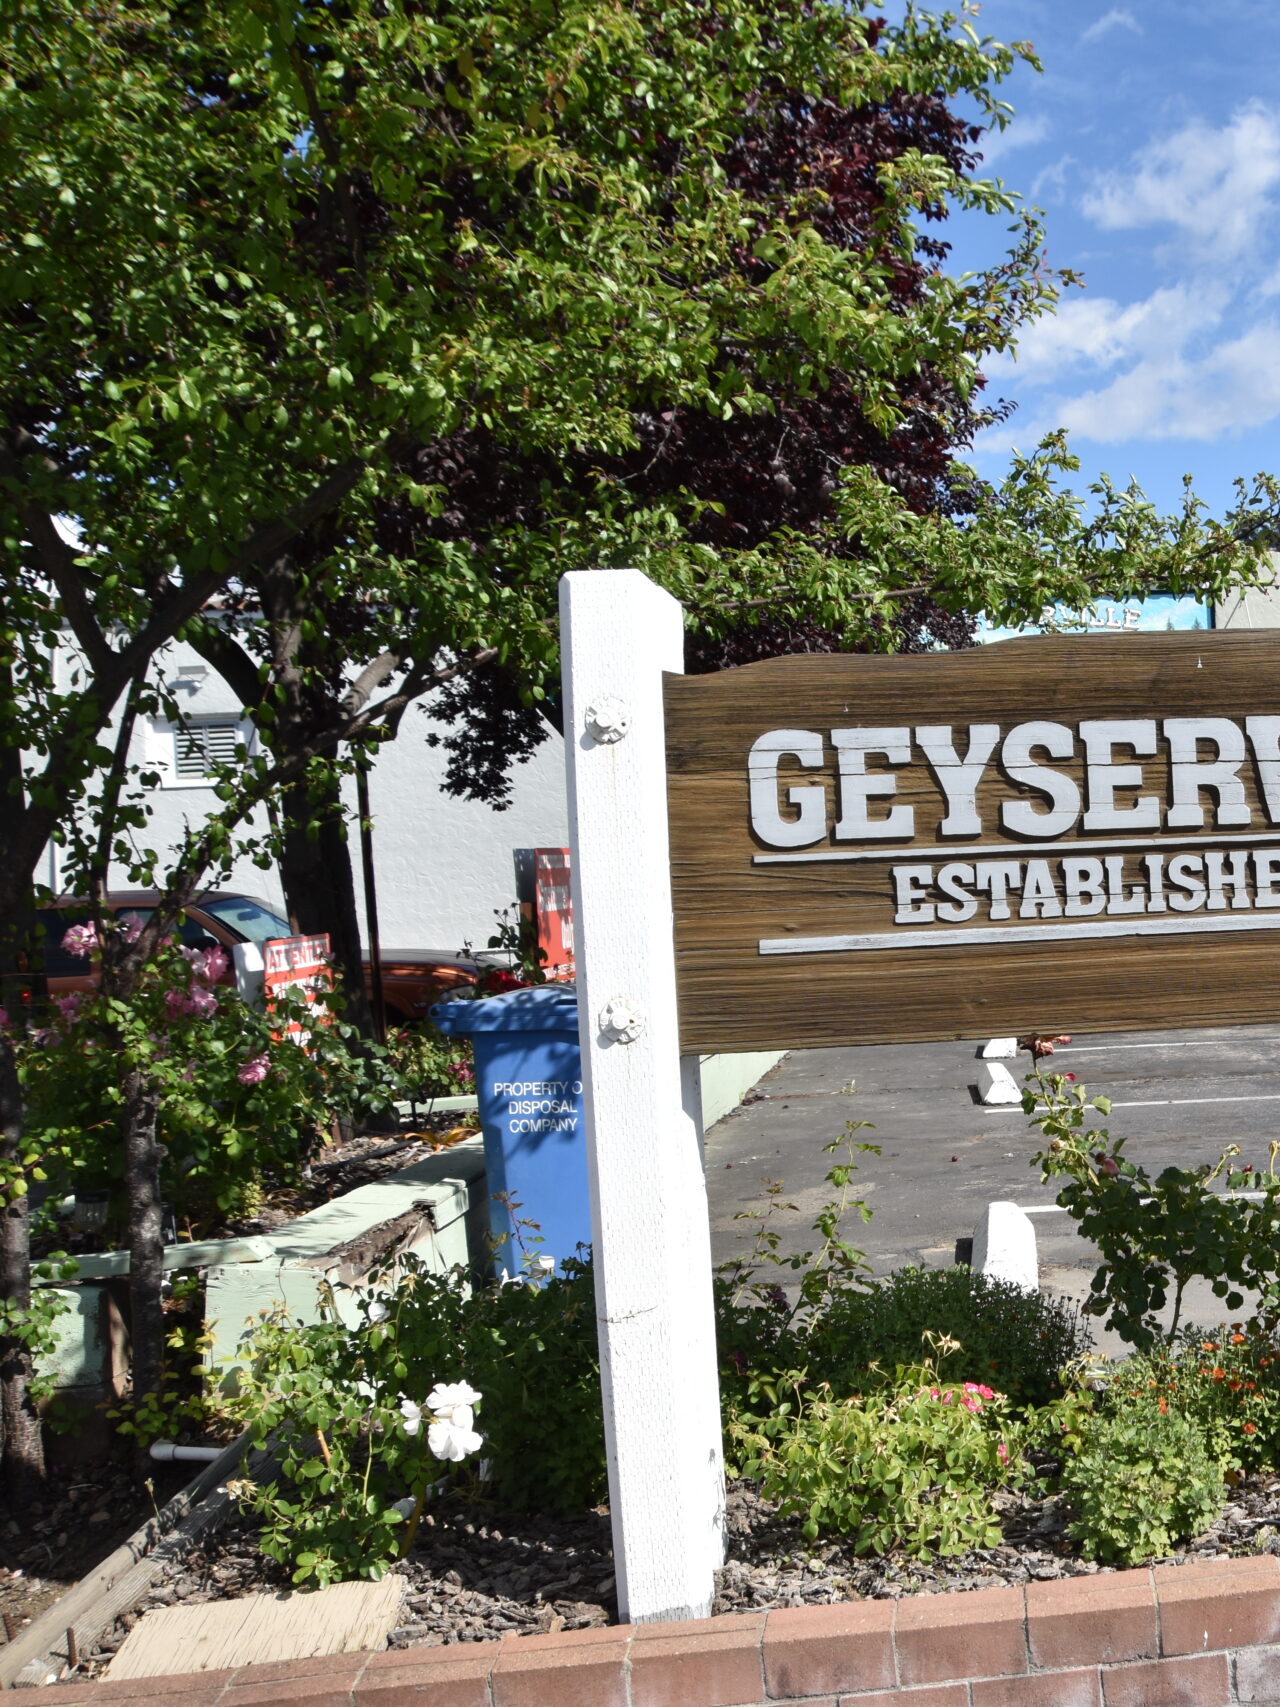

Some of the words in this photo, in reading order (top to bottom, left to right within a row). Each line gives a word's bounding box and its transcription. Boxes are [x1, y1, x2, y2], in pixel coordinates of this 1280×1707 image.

[268, 943, 327, 969] ATTENT
[494, 1081, 568, 1096] PROPERTY
[572, 1081, 583, 1095] O
[508, 1101, 577, 1115] DISPOSAL
[509, 1118, 577, 1133] COMPANY
